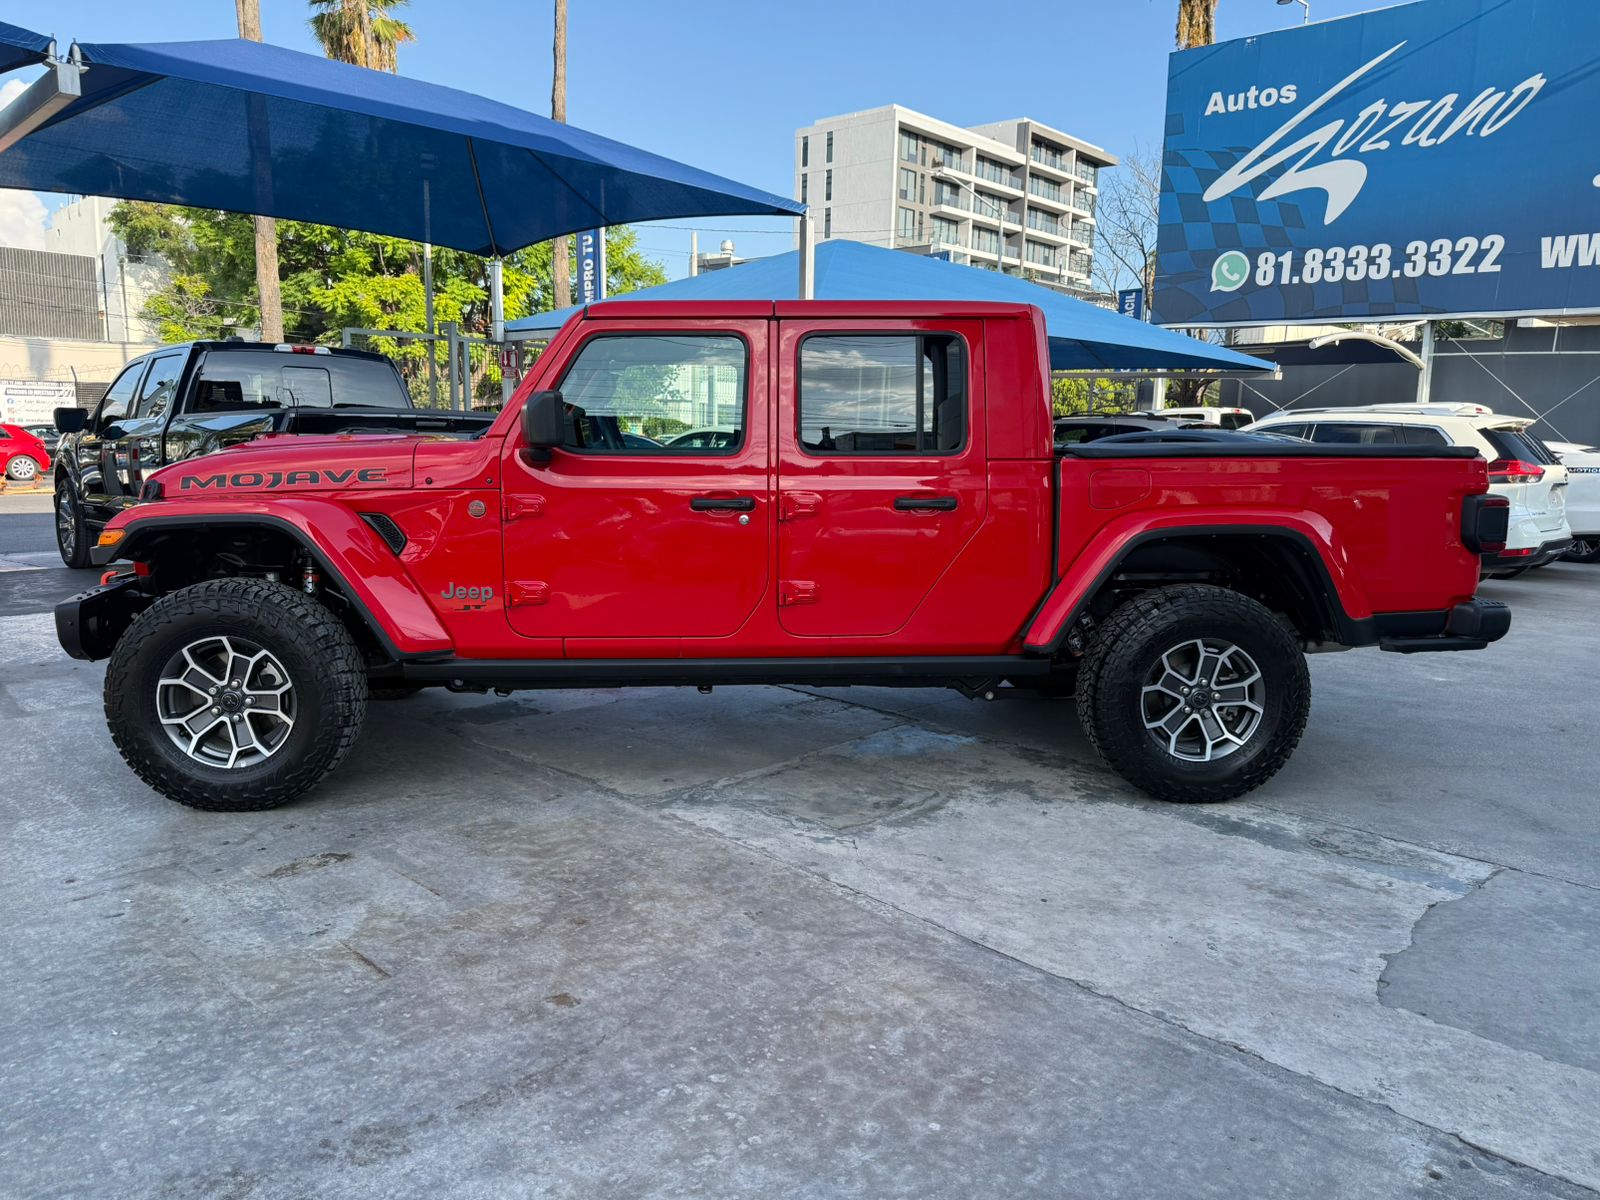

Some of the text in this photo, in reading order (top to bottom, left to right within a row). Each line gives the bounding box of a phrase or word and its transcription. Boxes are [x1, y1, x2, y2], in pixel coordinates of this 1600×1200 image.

[1204, 83, 1298, 116] Autos
[1202, 40, 1548, 226] Lozano
[582, 234, 594, 257] TU
[1255, 234, 1506, 287] 81.8333.3322
[179, 467, 389, 490] MOJAVE
[441, 581, 495, 604] Jeep
